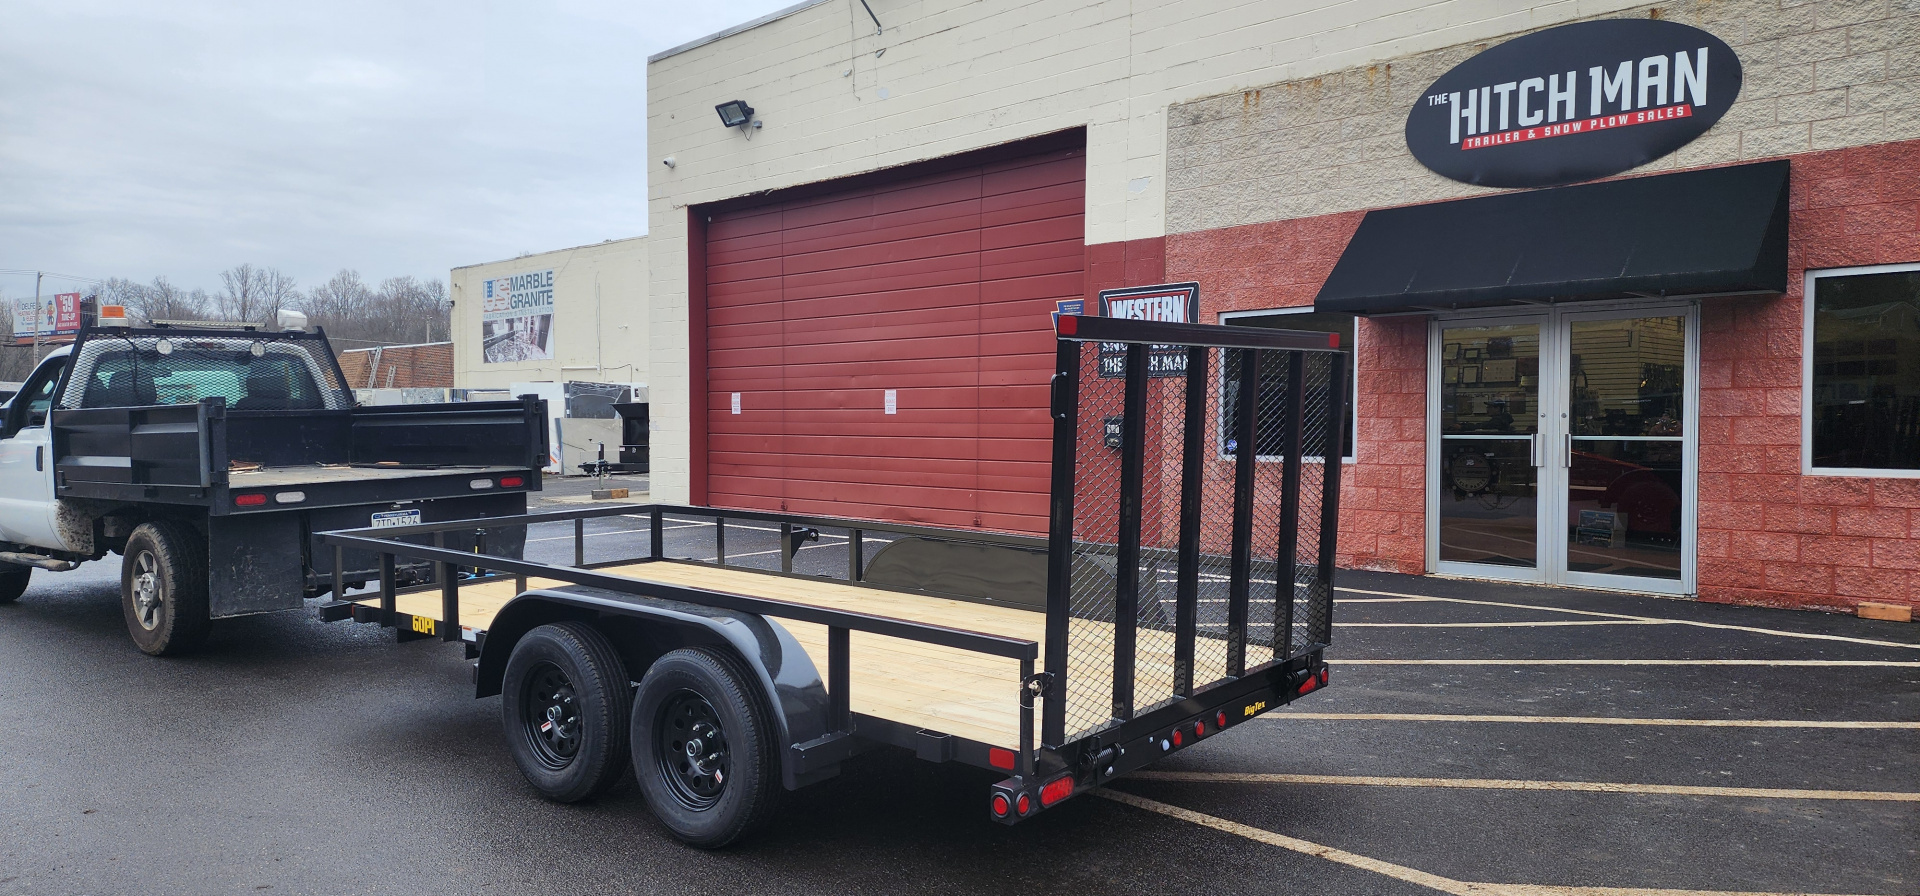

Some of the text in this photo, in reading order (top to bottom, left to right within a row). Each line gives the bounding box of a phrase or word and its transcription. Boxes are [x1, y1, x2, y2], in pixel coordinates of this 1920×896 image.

[1428, 46, 1709, 145] THE HITCH MAN
[1467, 106, 1685, 148] TRAILER & SNOW PLOW SALES
[510, 270, 553, 293] MARBLE
[510, 289, 553, 310] GRANITE
[1111, 295, 1185, 323] WESTERN
